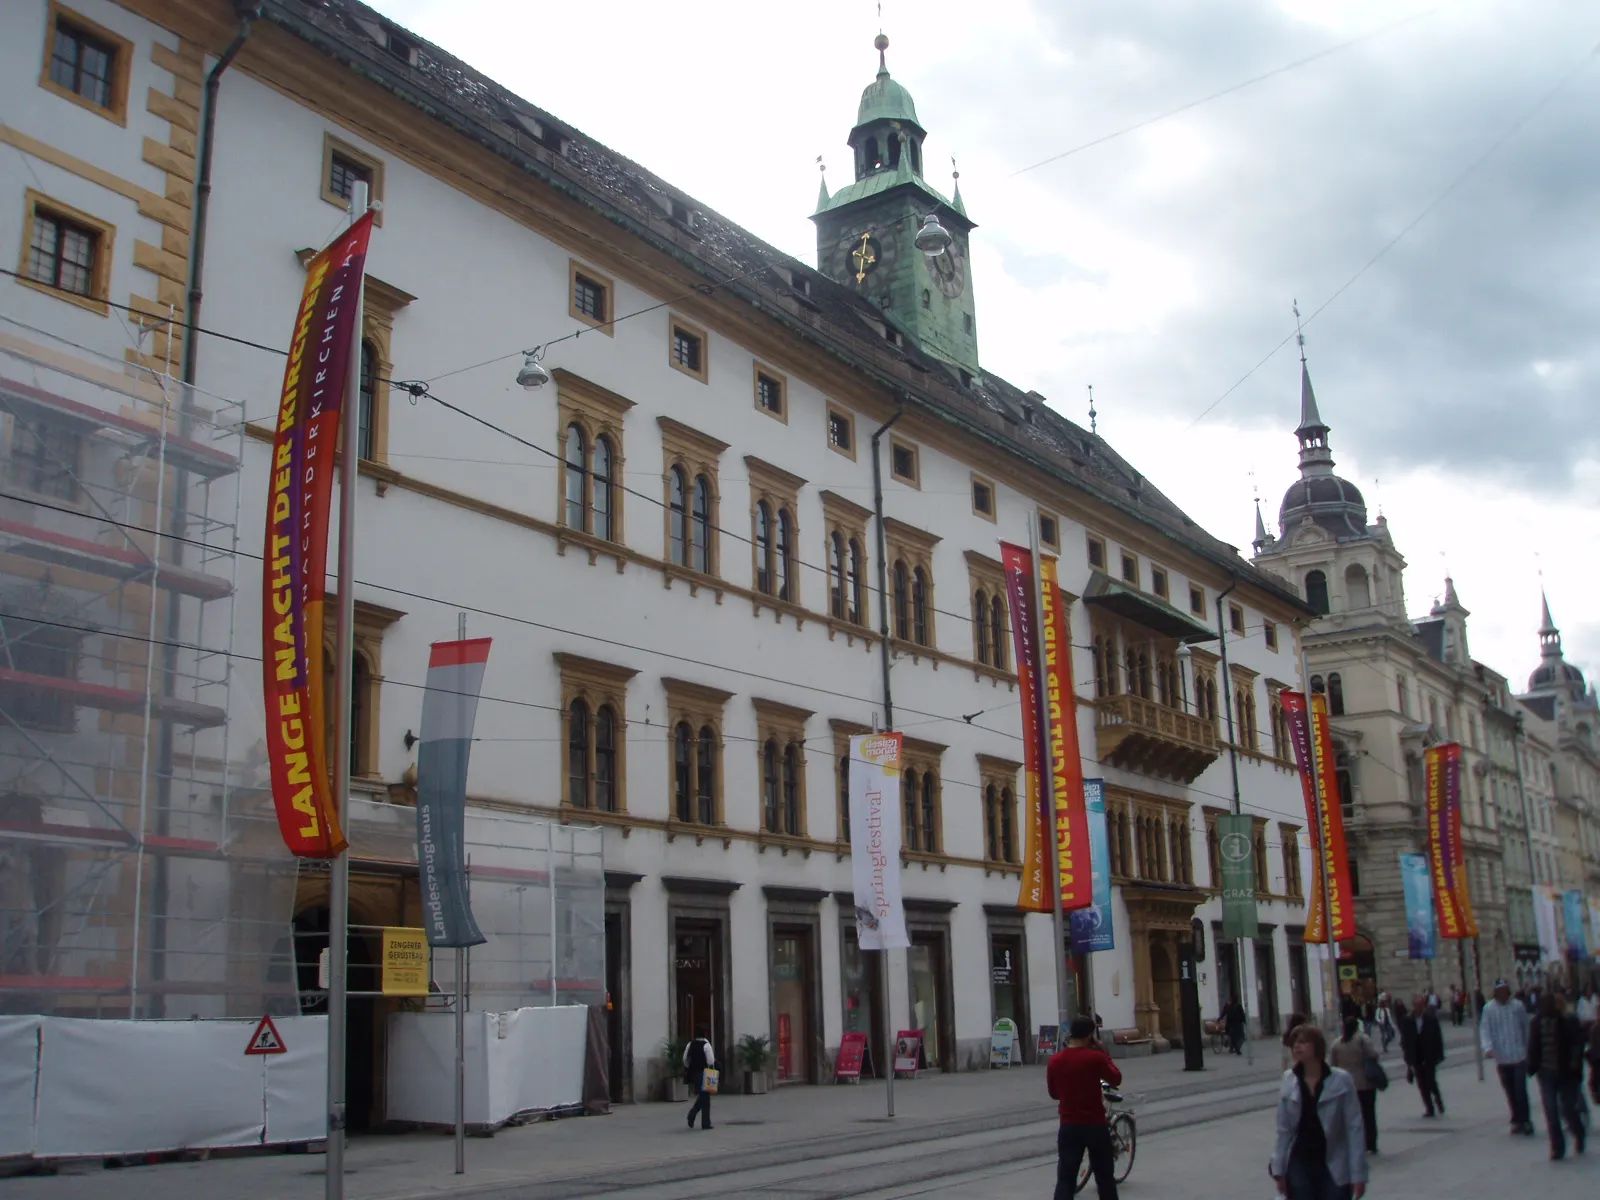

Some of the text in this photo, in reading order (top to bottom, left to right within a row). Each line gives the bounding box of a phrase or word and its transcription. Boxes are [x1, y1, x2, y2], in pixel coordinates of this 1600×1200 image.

[272, 259, 330, 838] LANGE NACHT DER KIRCHEN
[421, 804, 447, 940] Landeszeughaus
[865, 790, 890, 917] springfestival
[1223, 888, 1254, 898] GRAZ
[1429, 752, 1459, 934] LANGE NACHT DER KIRCHEN
[390, 940, 422, 950] ZENGERER
